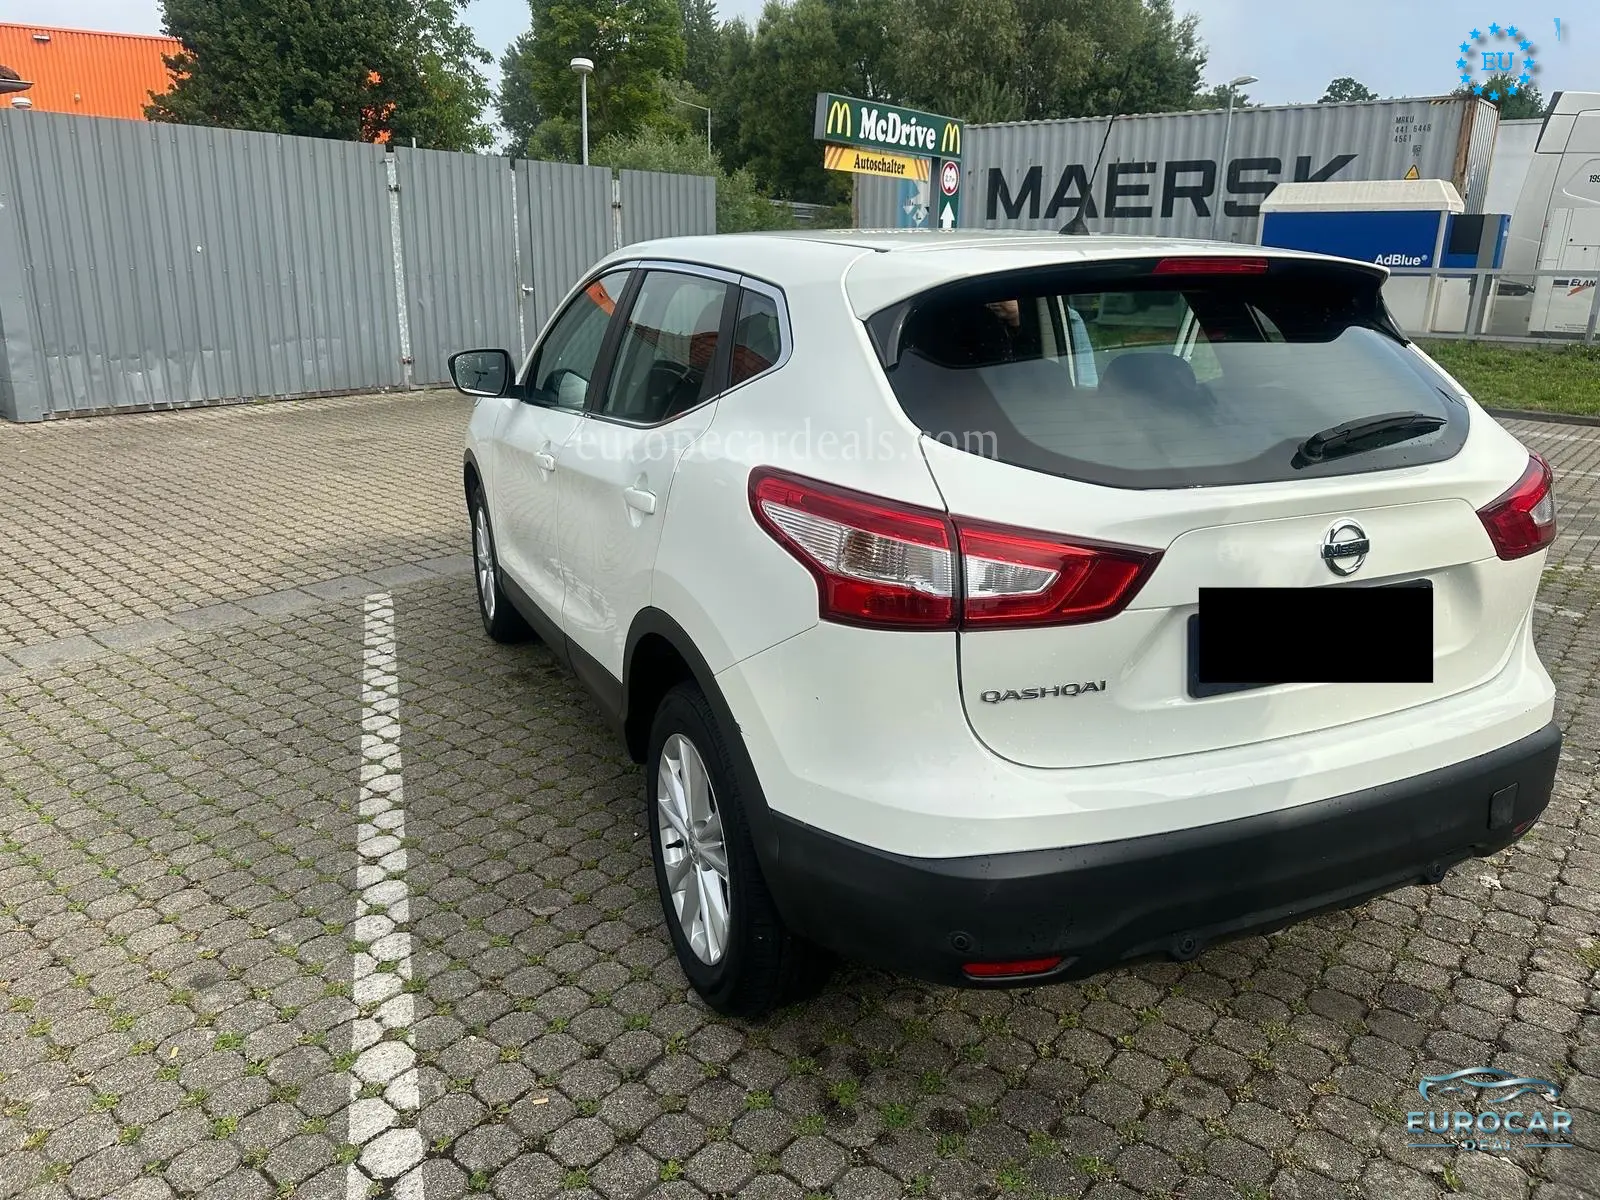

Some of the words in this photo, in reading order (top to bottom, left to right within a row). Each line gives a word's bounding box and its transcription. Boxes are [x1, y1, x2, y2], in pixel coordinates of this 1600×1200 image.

[860, 107, 936, 150] McDrive
[853, 153, 905, 174] Autoschalter
[980, 680, 1106, 704] QASHQAI
